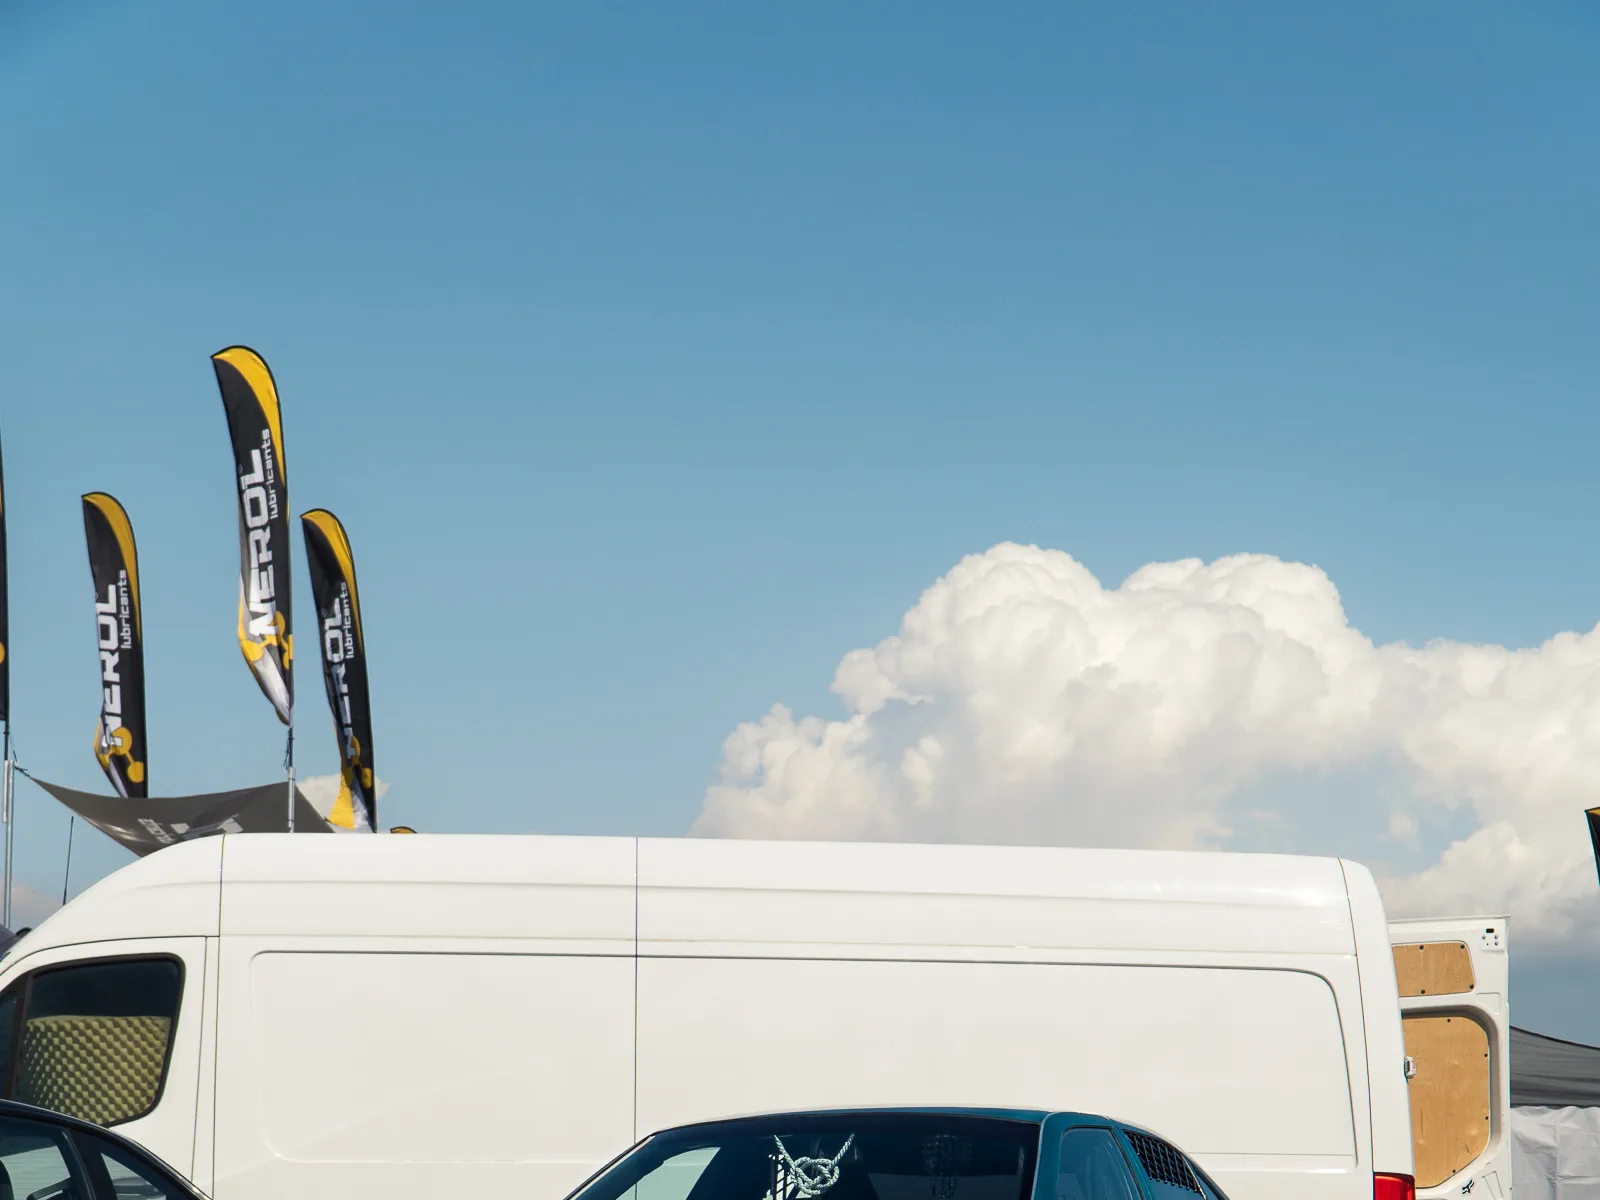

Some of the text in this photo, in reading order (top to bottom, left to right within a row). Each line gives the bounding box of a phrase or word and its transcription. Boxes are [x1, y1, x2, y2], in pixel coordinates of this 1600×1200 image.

[261, 428, 279, 519] lubricants
[240, 449, 279, 636] NEROL
[118, 569, 132, 649] lubricants
[341, 581, 355, 659] lubricants
[96, 584, 123, 747] NEROL
